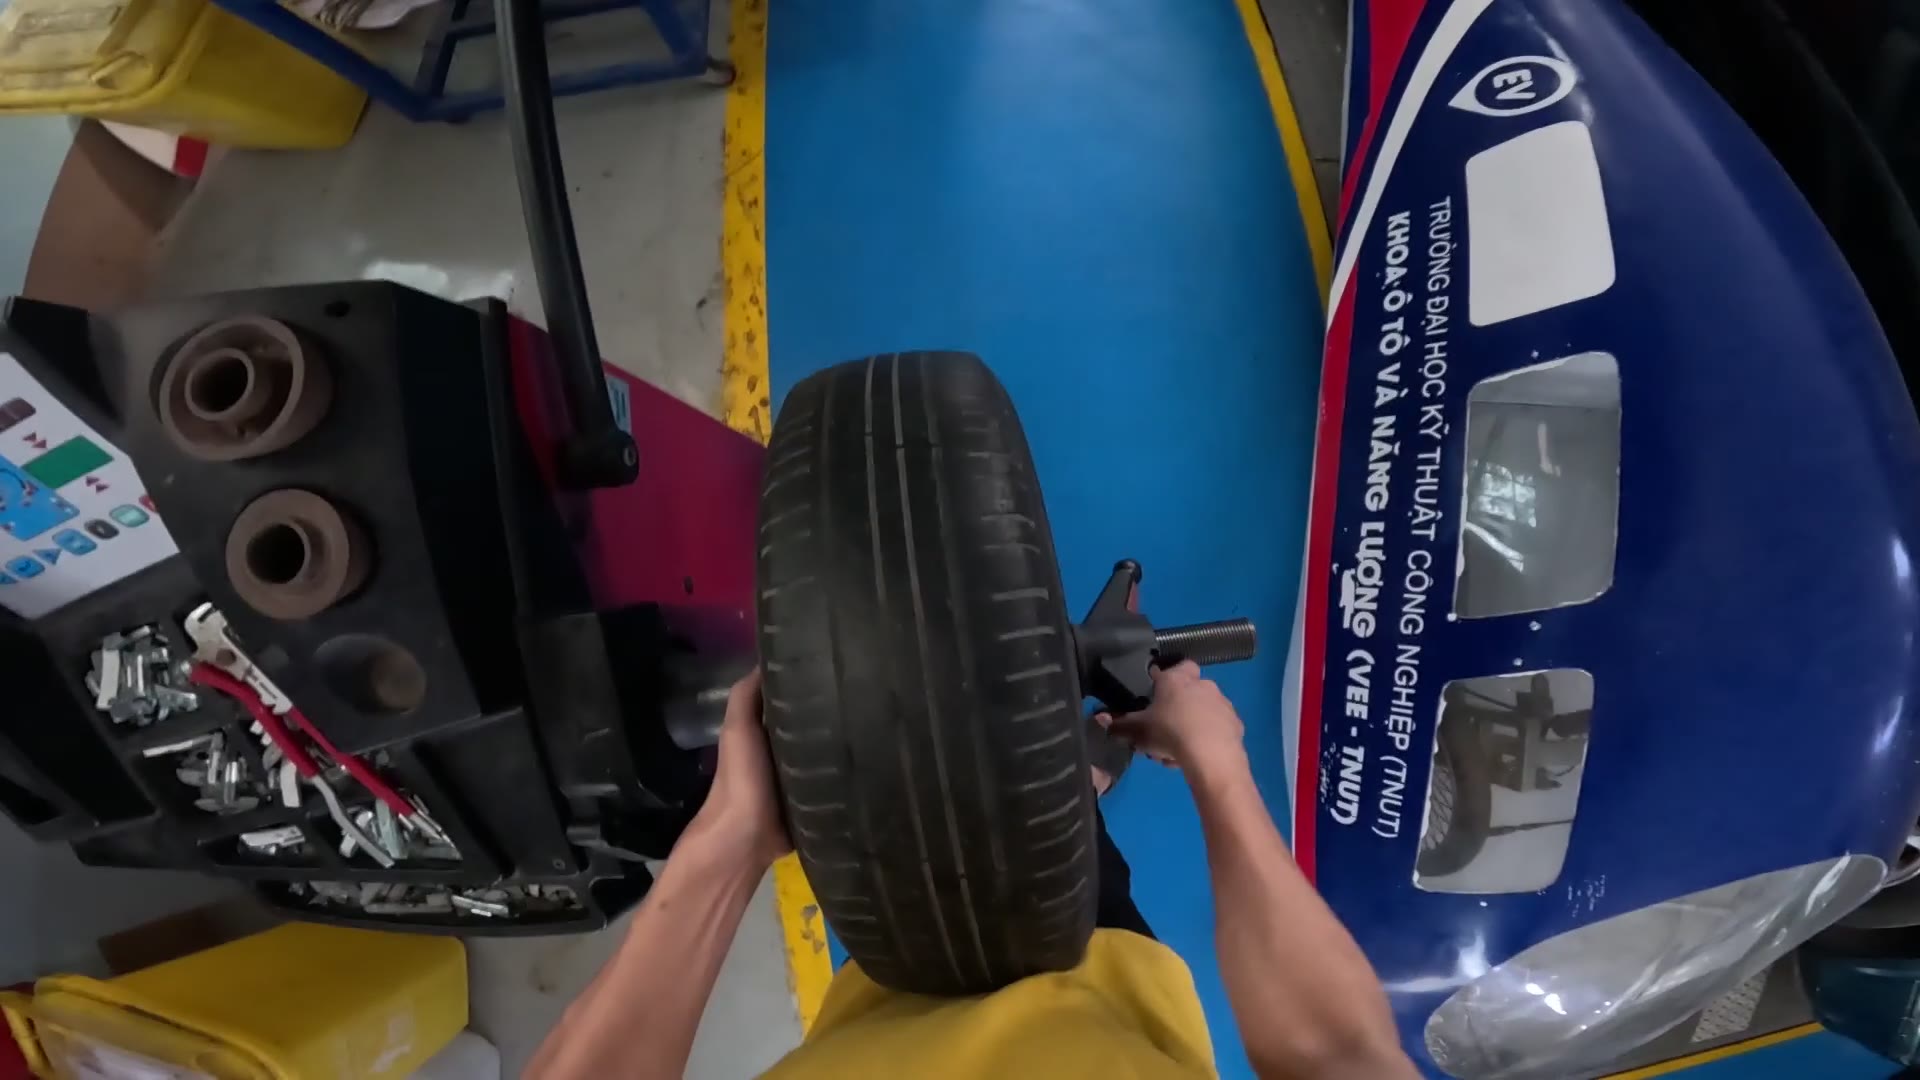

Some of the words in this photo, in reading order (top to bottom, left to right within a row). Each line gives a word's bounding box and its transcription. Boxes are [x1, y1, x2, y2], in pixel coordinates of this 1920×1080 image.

[1493, 68, 1536, 100] EV
[1427, 197, 1456, 292] TRƯỜNG
[1383, 289, 1413, 312] Ô
[1421, 296, 1450, 336] ĐẠI
[1380, 317, 1411, 356] TÔ
[1375, 362, 1408, 408] VÀ
[1418, 341, 1447, 398] HỌC
[1419, 404, 1449, 440] KỸ
[1365, 416, 1401, 512] NĂNG
[1408, 446, 1443, 542] THUẬT
[1400, 551, 1434, 635] CÔNG
[1345, 649, 1375, 720] (VEE
[1384, 644, 1420, 751] NGHIỆP
[1350, 726, 1358, 737] -
[1331, 743, 1365, 825] TNUT)
[1372, 754, 1407, 838] (TNUT)
